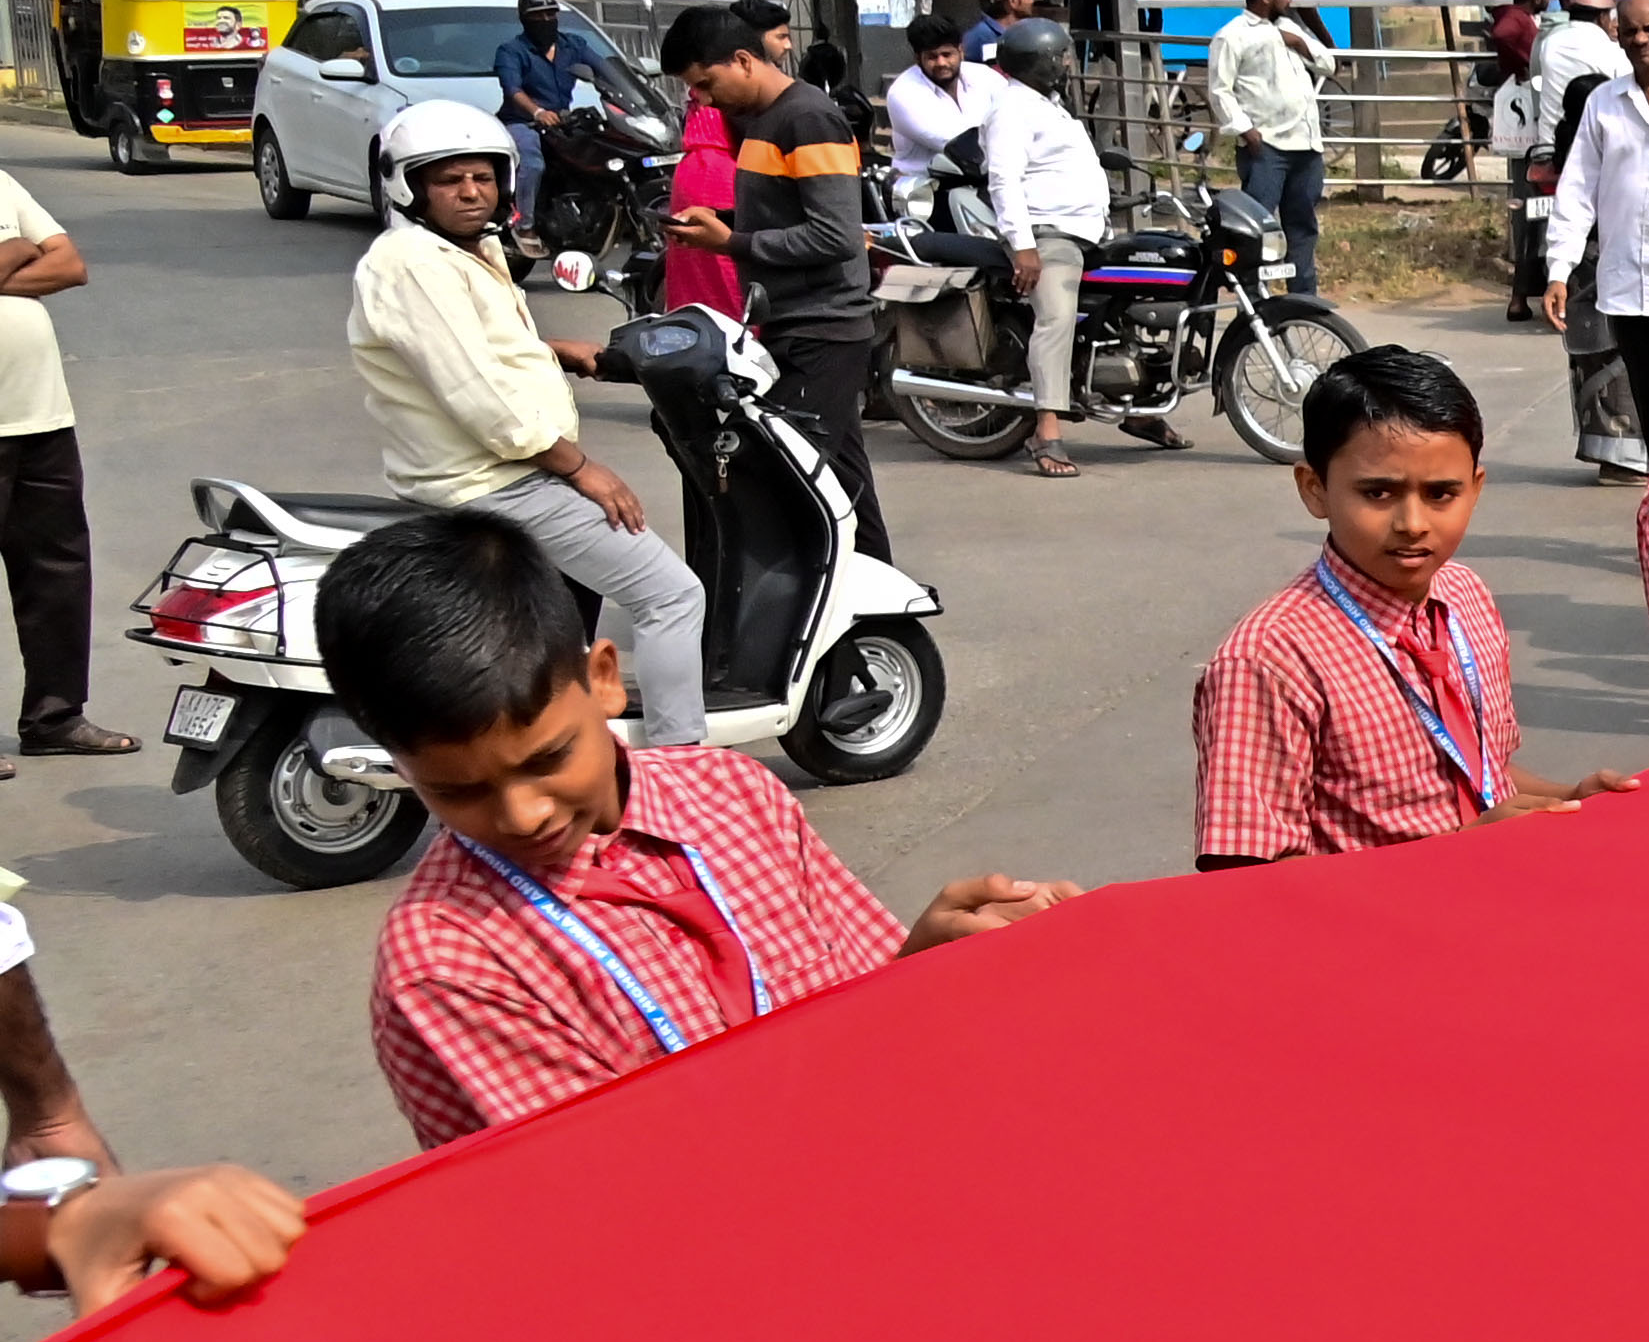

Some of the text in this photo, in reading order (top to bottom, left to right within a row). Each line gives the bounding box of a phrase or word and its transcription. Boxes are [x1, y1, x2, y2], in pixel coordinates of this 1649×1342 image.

[1337, 593, 1362, 619] HIGH
[508, 873, 545, 903] AND
[540, 900, 608, 960] PRIMARY
[605, 957, 657, 1015] HIGHER
